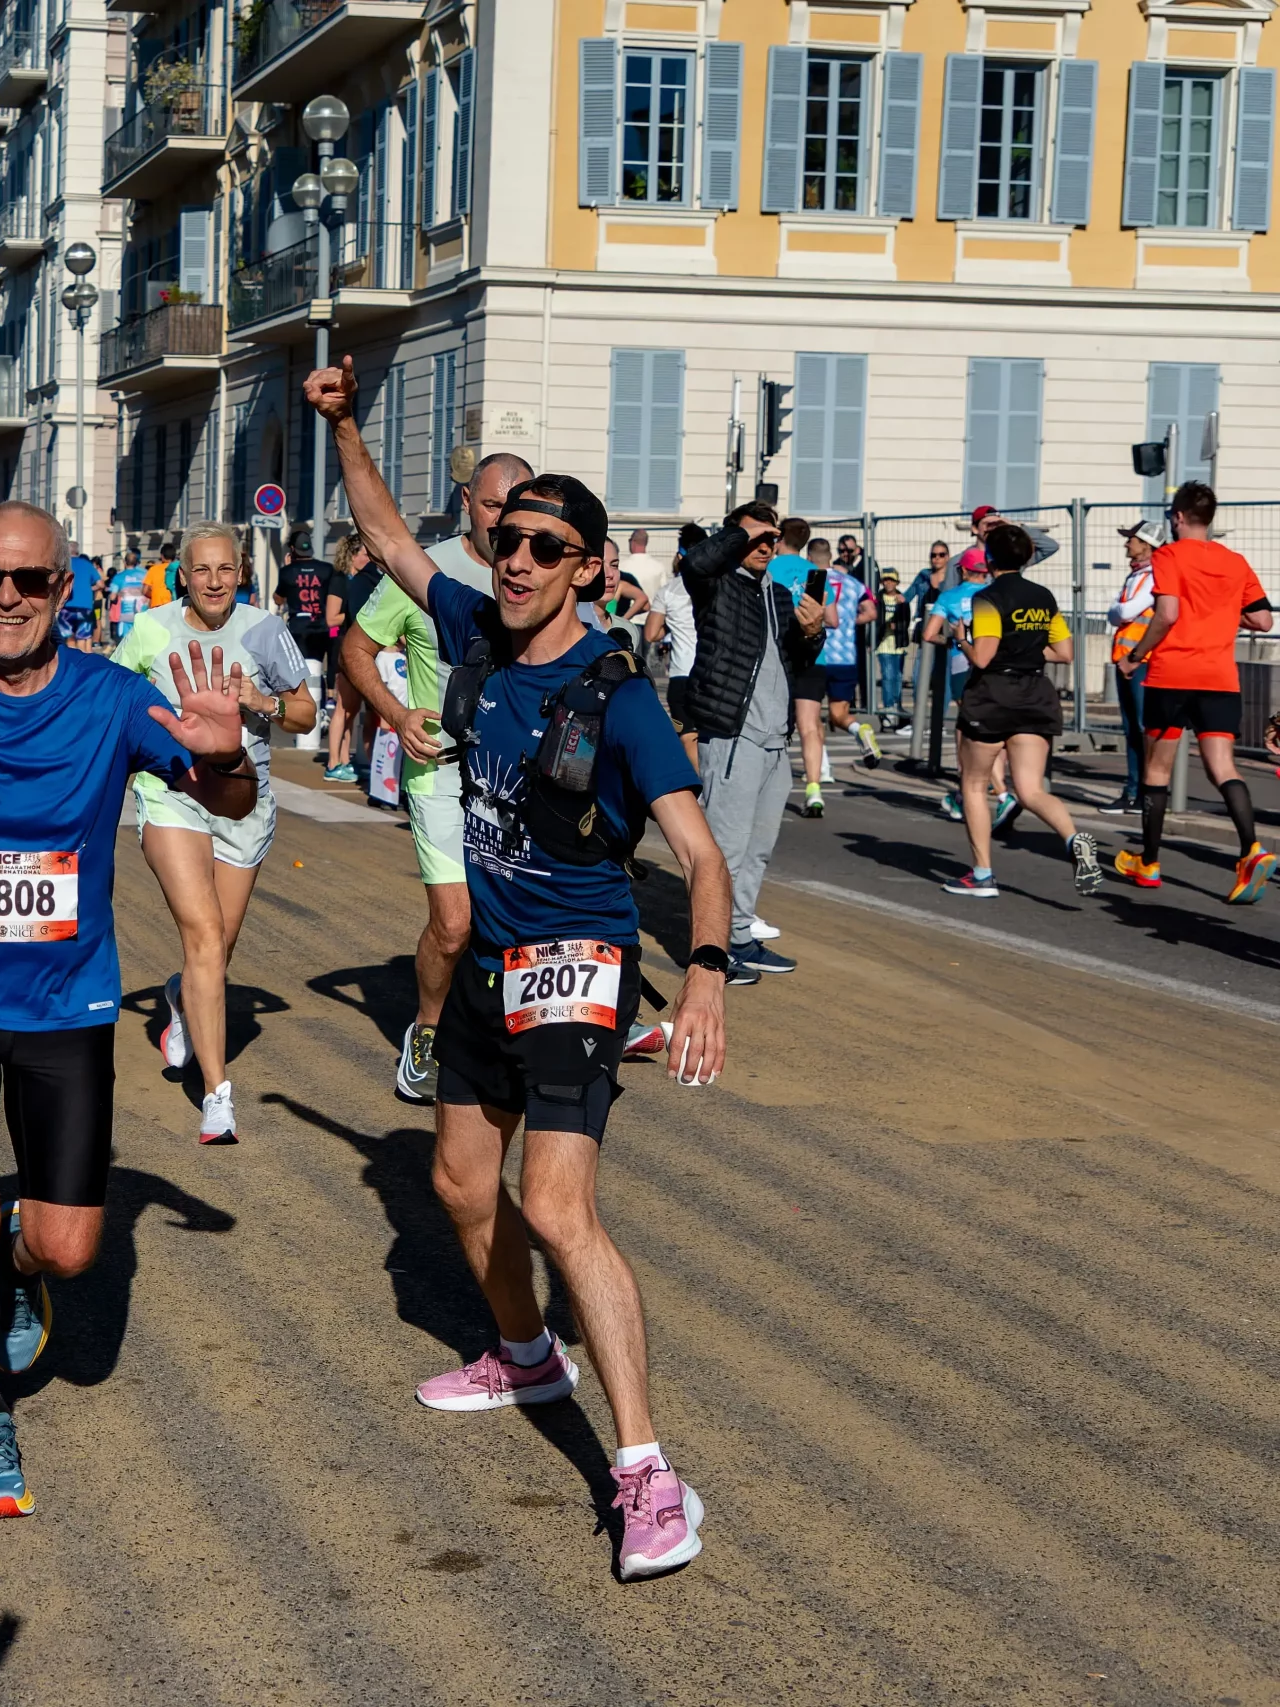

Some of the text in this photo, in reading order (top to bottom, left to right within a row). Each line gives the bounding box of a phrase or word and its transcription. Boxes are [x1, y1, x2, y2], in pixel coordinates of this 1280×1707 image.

[500, 868, 511, 878] 06
[9, 929, 35, 938] NICE
[519, 964, 598, 1005] 2807
[549, 1009, 575, 1018] NICE
